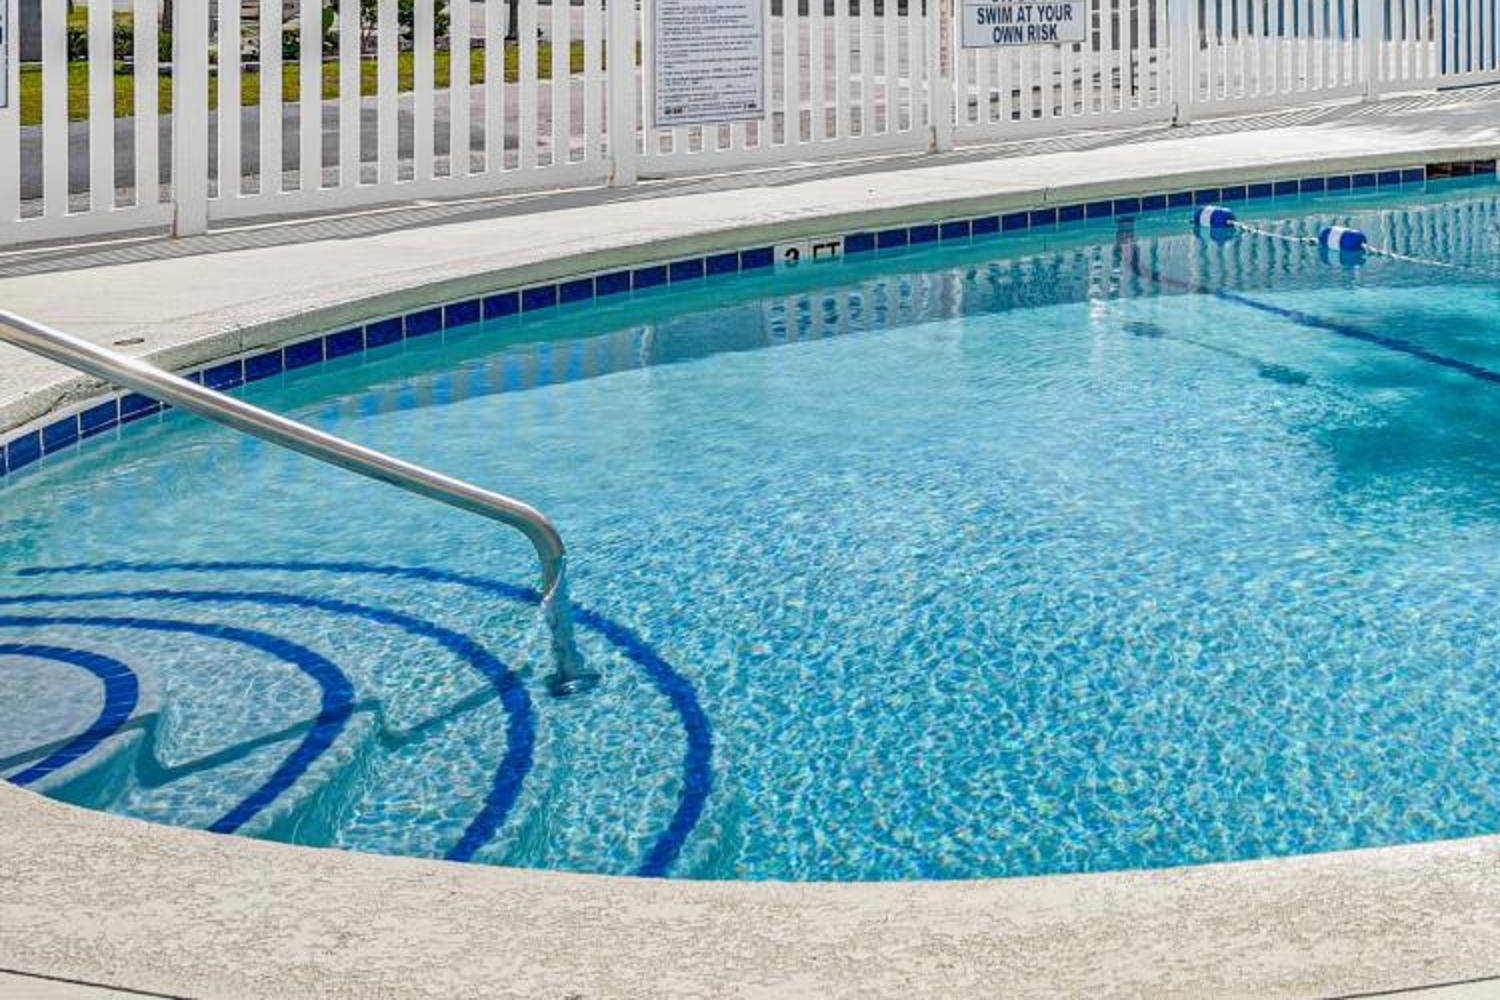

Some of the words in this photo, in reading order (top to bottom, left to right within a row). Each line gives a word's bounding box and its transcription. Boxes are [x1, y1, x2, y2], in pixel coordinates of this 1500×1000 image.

[977, 6, 1013, 25] SWIM
[1016, 6, 1032, 23] AT
[1037, 4, 1073, 21] YOUR
[993, 25, 1023, 43] OWN
[1027, 24, 1058, 42] RISK
